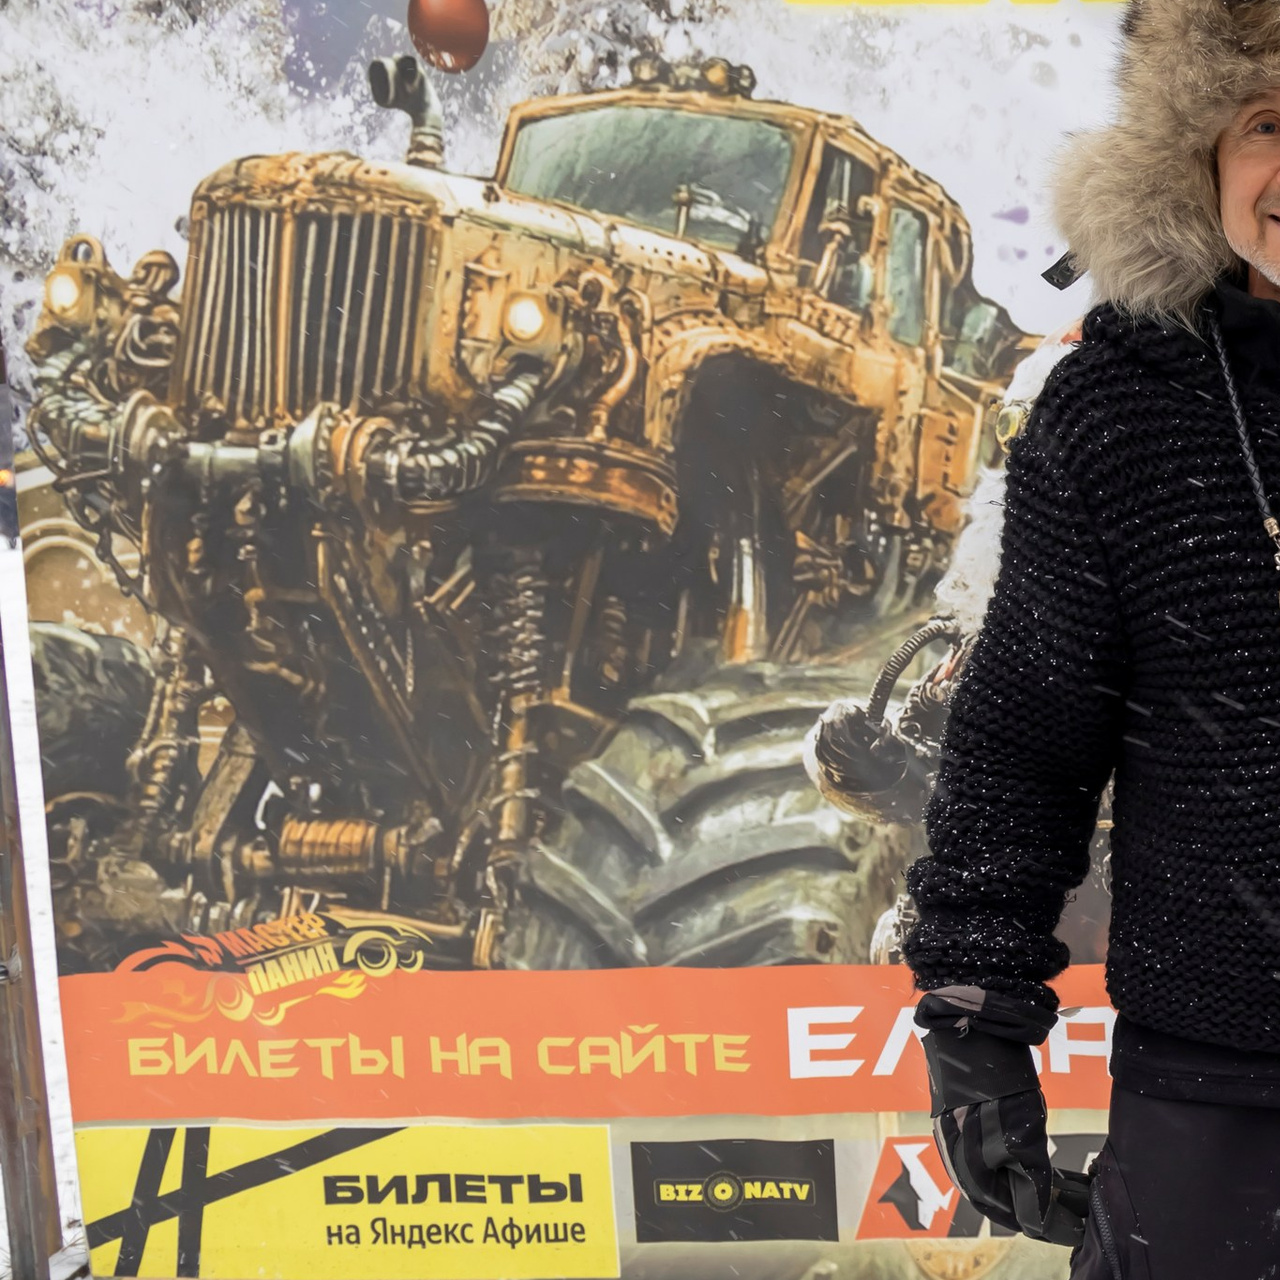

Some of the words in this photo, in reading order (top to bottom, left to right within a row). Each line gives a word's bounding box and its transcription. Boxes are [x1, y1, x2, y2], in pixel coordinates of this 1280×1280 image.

[215, 911, 330, 958] МАСТЕР
[247, 941, 341, 997] ПАНИН
[128, 1032, 405, 1081] БИЛЕТЫ
[430, 1032, 513, 1080] НА
[537, 1022, 752, 1080] САЙТЕ
[323, 1173, 584, 1205] БИЛЕТЫ
[326, 1221, 362, 1246] на
[370, 1218, 473, 1248] Яндекс
[482, 1218, 586, 1249] Афише
